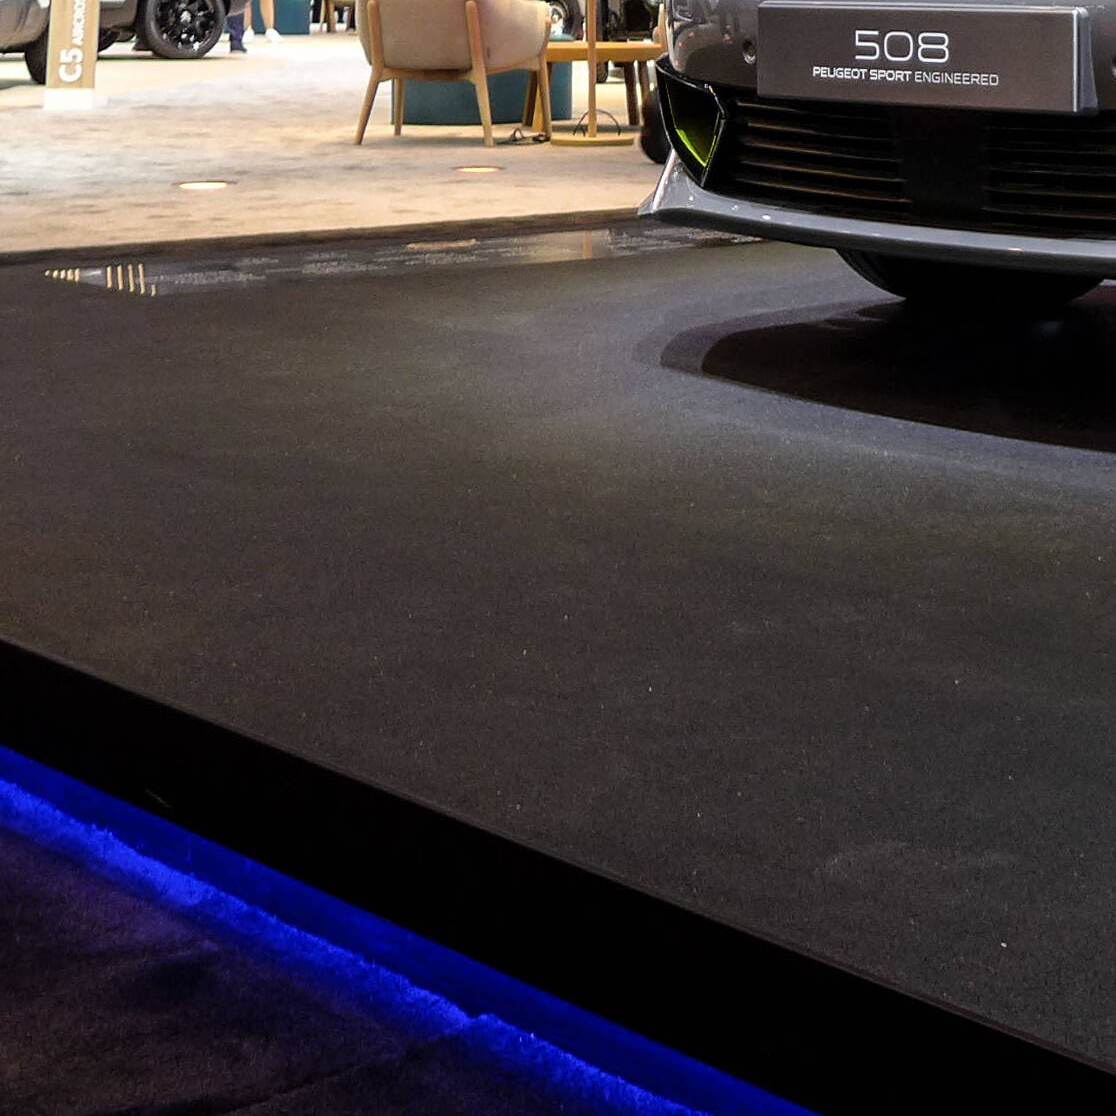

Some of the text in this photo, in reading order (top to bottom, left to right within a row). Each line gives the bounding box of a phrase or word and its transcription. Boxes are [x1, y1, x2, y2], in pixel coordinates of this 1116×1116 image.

[855, 30, 949, 63] 508
[59, 48, 84, 83] C5
[812, 66, 999, 86] PEUGEOT SPORT ENGINEERED
